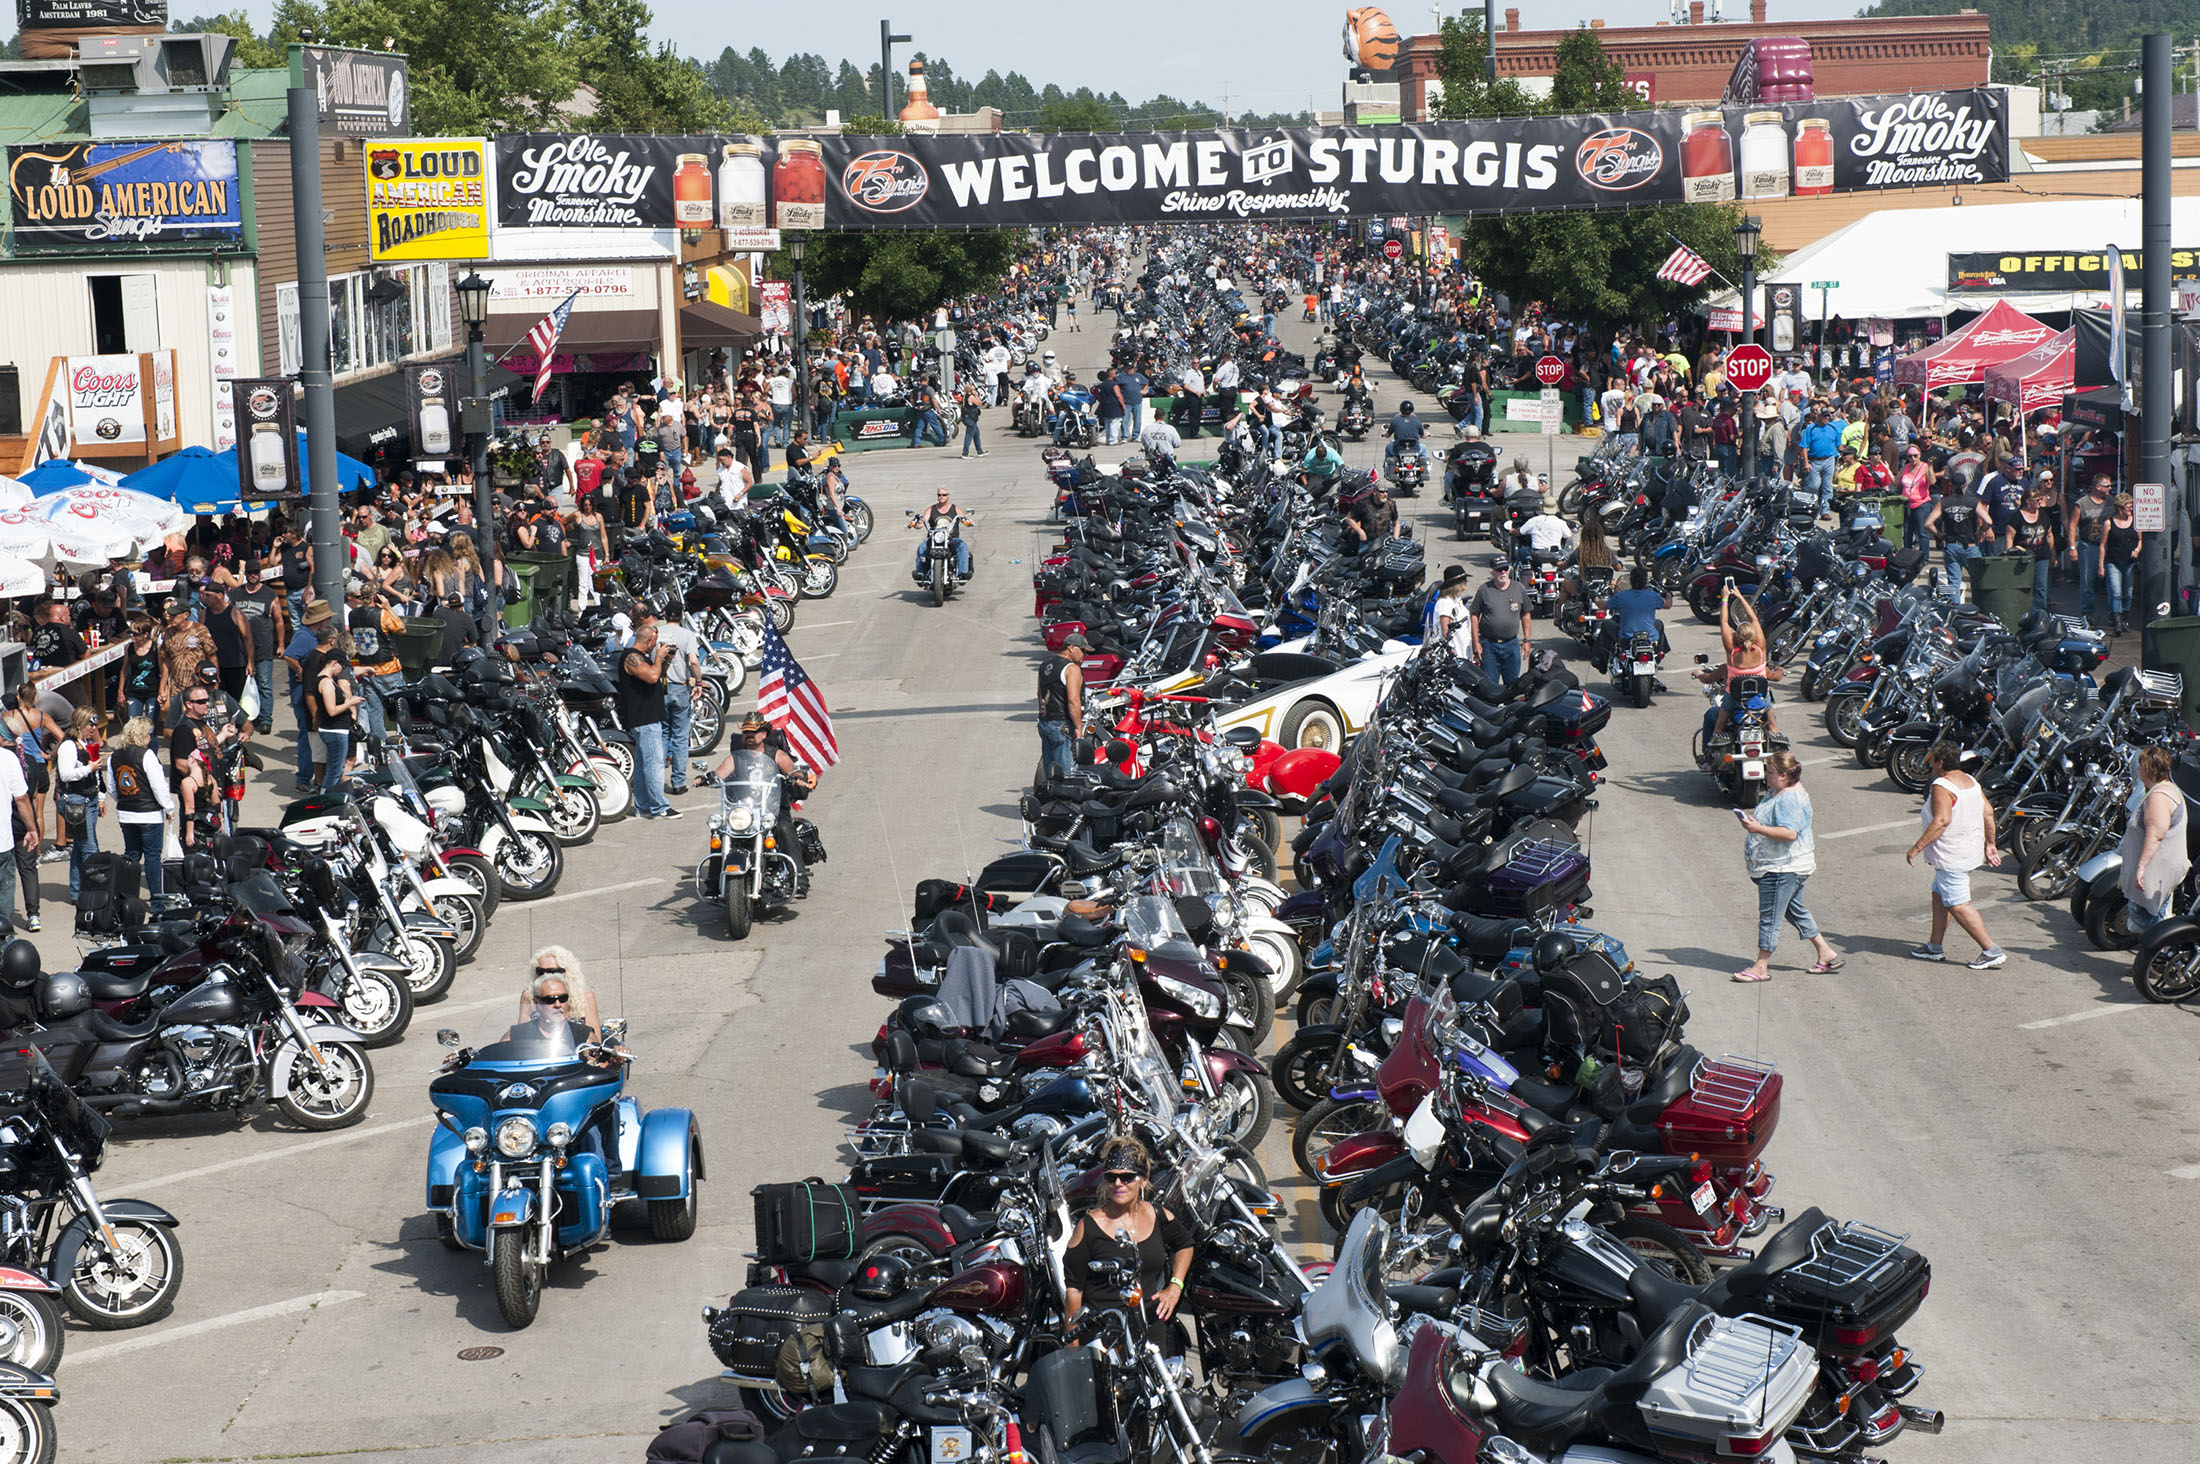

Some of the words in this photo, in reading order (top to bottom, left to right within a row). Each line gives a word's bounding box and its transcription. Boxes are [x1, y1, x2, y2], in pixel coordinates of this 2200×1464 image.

[52, 2, 69, 10] PALM
[69, 1, 93, 9] LEAVES
[39, 11, 81, 19] AMSTERDAM
[85, 10, 108, 18] 1981
[353, 63, 387, 107] AMERICAN
[1909, 94, 1954, 121] Ole
[337, 115, 388, 132] ROADHOUSE
[1851, 103, 1996, 161] Smoky
[567, 135, 613, 164] Ole
[403, 150, 482, 179] LOUD
[1595, 152, 1660, 176] Sturgis
[1896, 154, 1942, 167] Tennessee
[512, 141, 656, 204] Smoky
[939, 139, 1229, 209] WELCOME
[1248, 146, 1286, 176] TO
[1308, 137, 1559, 191] STURGIS
[1866, 159, 1984, 185] Moonshine
[372, 181, 483, 209] AMERICAN
[862, 175, 928, 200] Sturgis
[1693, 180, 1721, 193] Smoky
[25, 184, 94, 221] LOUD
[101, 180, 227, 218] AMERICAN
[556, 193, 600, 207] Tennessee
[1160, 190, 1226, 213] Shine
[527, 197, 642, 226] Moonshine
[785, 208, 812, 220] Smoky
[84, 211, 163, 242] Sturgis
[377, 211, 480, 254] ROADHOUSE
[739, 229, 770, 237] ACCESSORIES
[1385, 244, 1401, 254] STOP
[1999, 251, 2143, 273] OFFICIA
[2171, 251, 2200, 268] S
[515, 269, 570, 279] ORIGINAL
[576, 268, 627, 277] APPAREL
[532, 277, 615, 287] ACCESSORIES
[1958, 271, 1984, 280] Motorcycle
[1988, 277, 2007, 286] USA
[212, 329, 232, 339] Coors
[1969, 329, 2047, 344] Budweiser
[214, 365, 235, 374] Coors
[1537, 364, 1562, 376] STOP
[1728, 358, 1769, 378] STOP
[1928, 367, 1975, 379] Budweiser
[72, 365, 138, 393] Coors
[75, 390, 135, 408] LIGHT
[863, 423, 898, 434] AMSOIL
[2143, 488, 2154, 496] NO
[2136, 497, 2162, 505] PARKING
